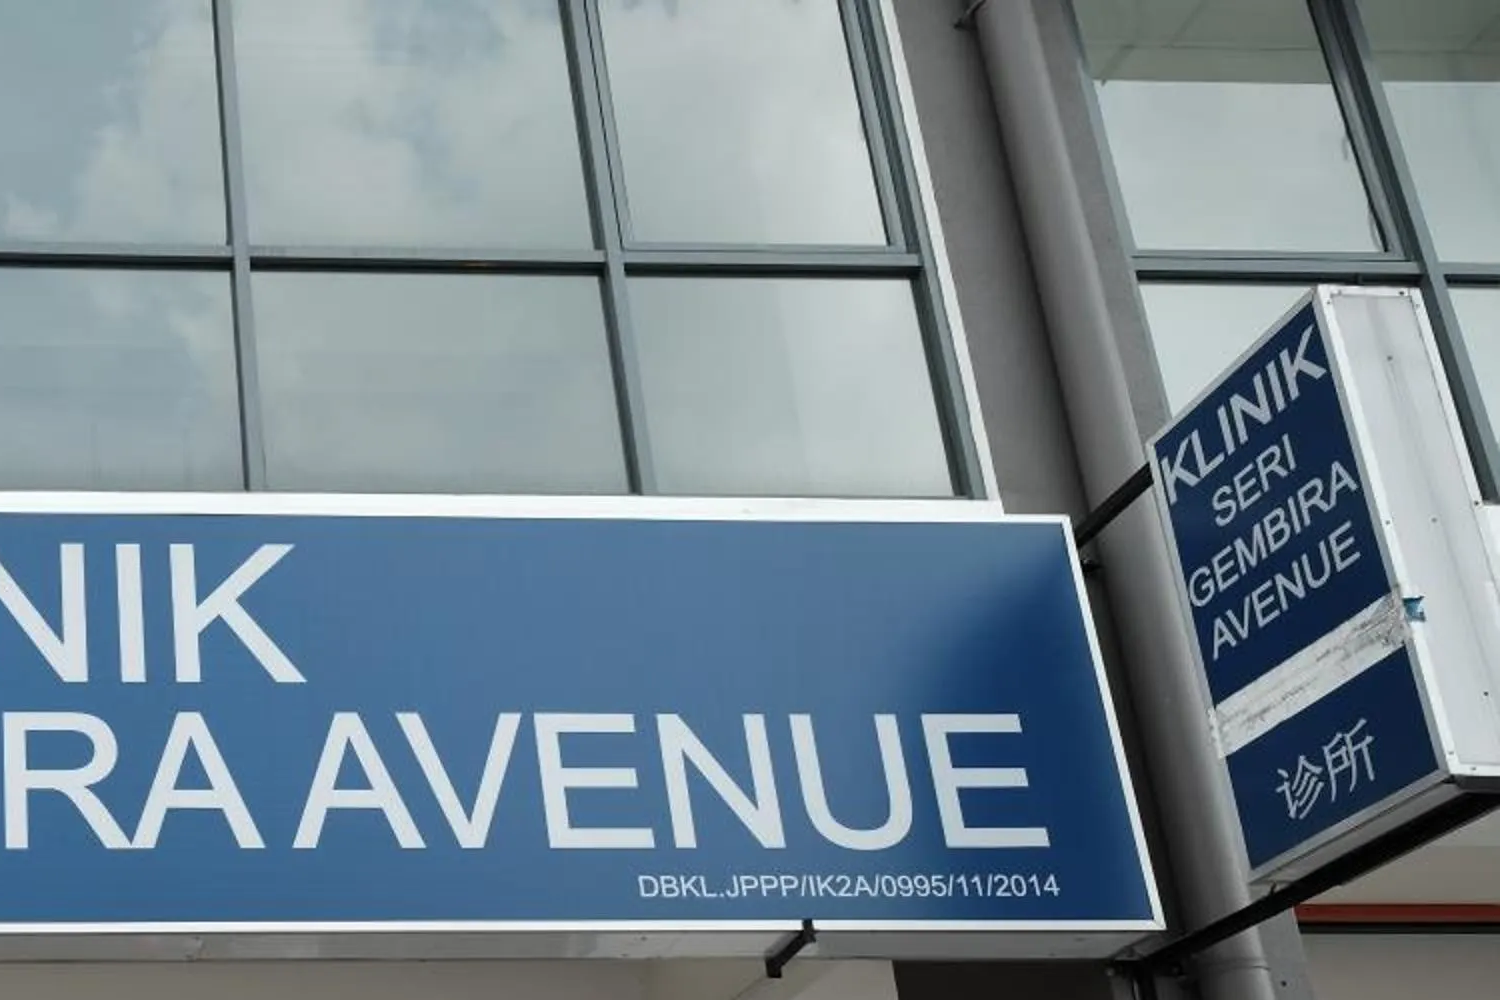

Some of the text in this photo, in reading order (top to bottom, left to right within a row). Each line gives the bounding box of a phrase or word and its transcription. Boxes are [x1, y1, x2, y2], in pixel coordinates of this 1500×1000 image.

[1159, 323, 1327, 505] KLINIK
[1211, 433, 1296, 527] SERI
[1189, 460, 1358, 607] GEMBIRA
[1213, 520, 1361, 660] AVENUE
[292, 711, 1051, 851] AVENUE
[1275, 717, 1376, 819] 诊所
[637, 874, 1060, 898] DBKL.JPPP/IK2A/0995/11/2014
